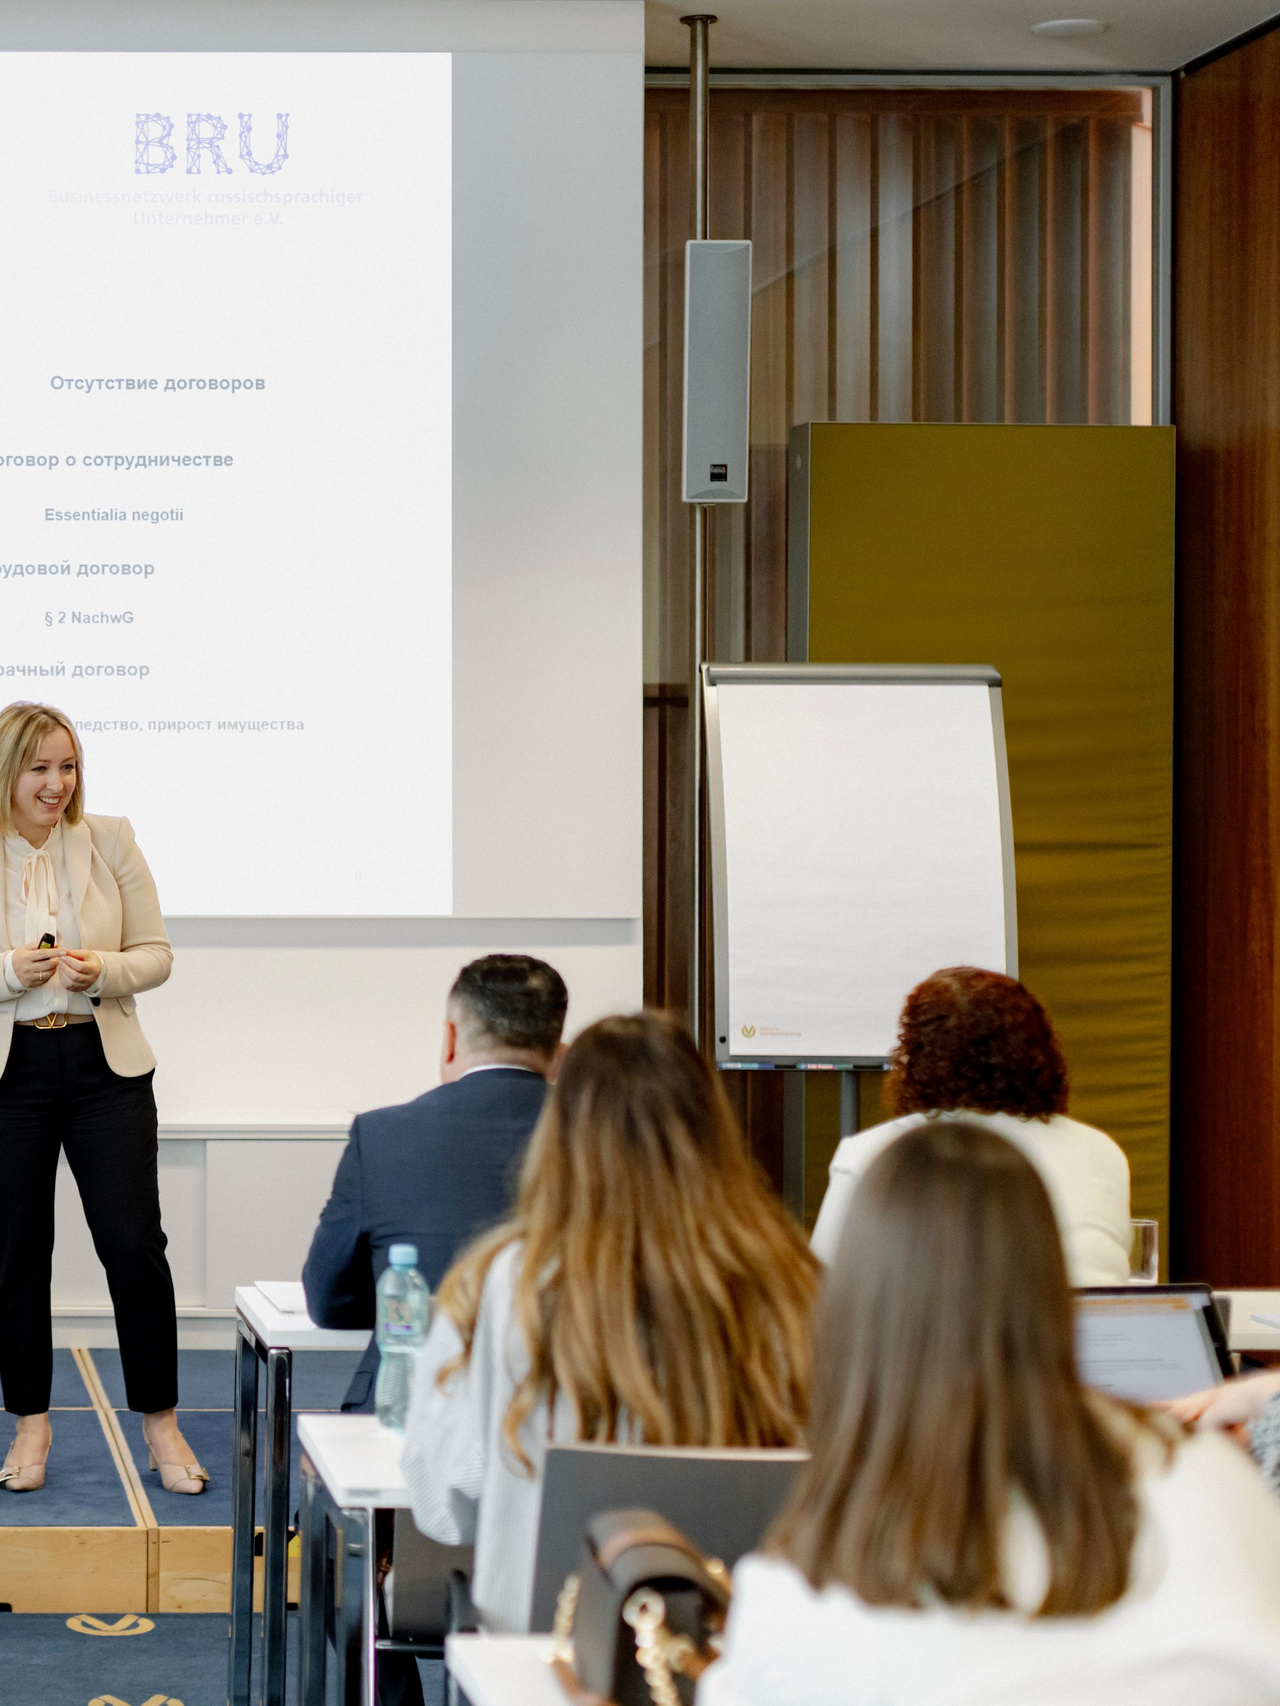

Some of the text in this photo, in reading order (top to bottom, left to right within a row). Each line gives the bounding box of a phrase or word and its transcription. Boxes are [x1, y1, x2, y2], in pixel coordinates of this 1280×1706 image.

[134, 112, 290, 175] BRU
[48, 189, 363, 207] Businessnetzwerk russischsprachiger
[133, 211, 283, 226] Unternehmer e.V.
[50, 374, 266, 395] Отсутствие договоров
[65, 455, 77, 467] о
[82, 455, 234, 471] сотрудничестве
[44, 507, 184, 525] Essentialia negotii
[76, 563, 155, 579] договор
[44, 610, 135, 627] § 2 NachwG
[70, 664, 150, 680] договор
[74, 719, 305, 734] ледство, прирост имущества
